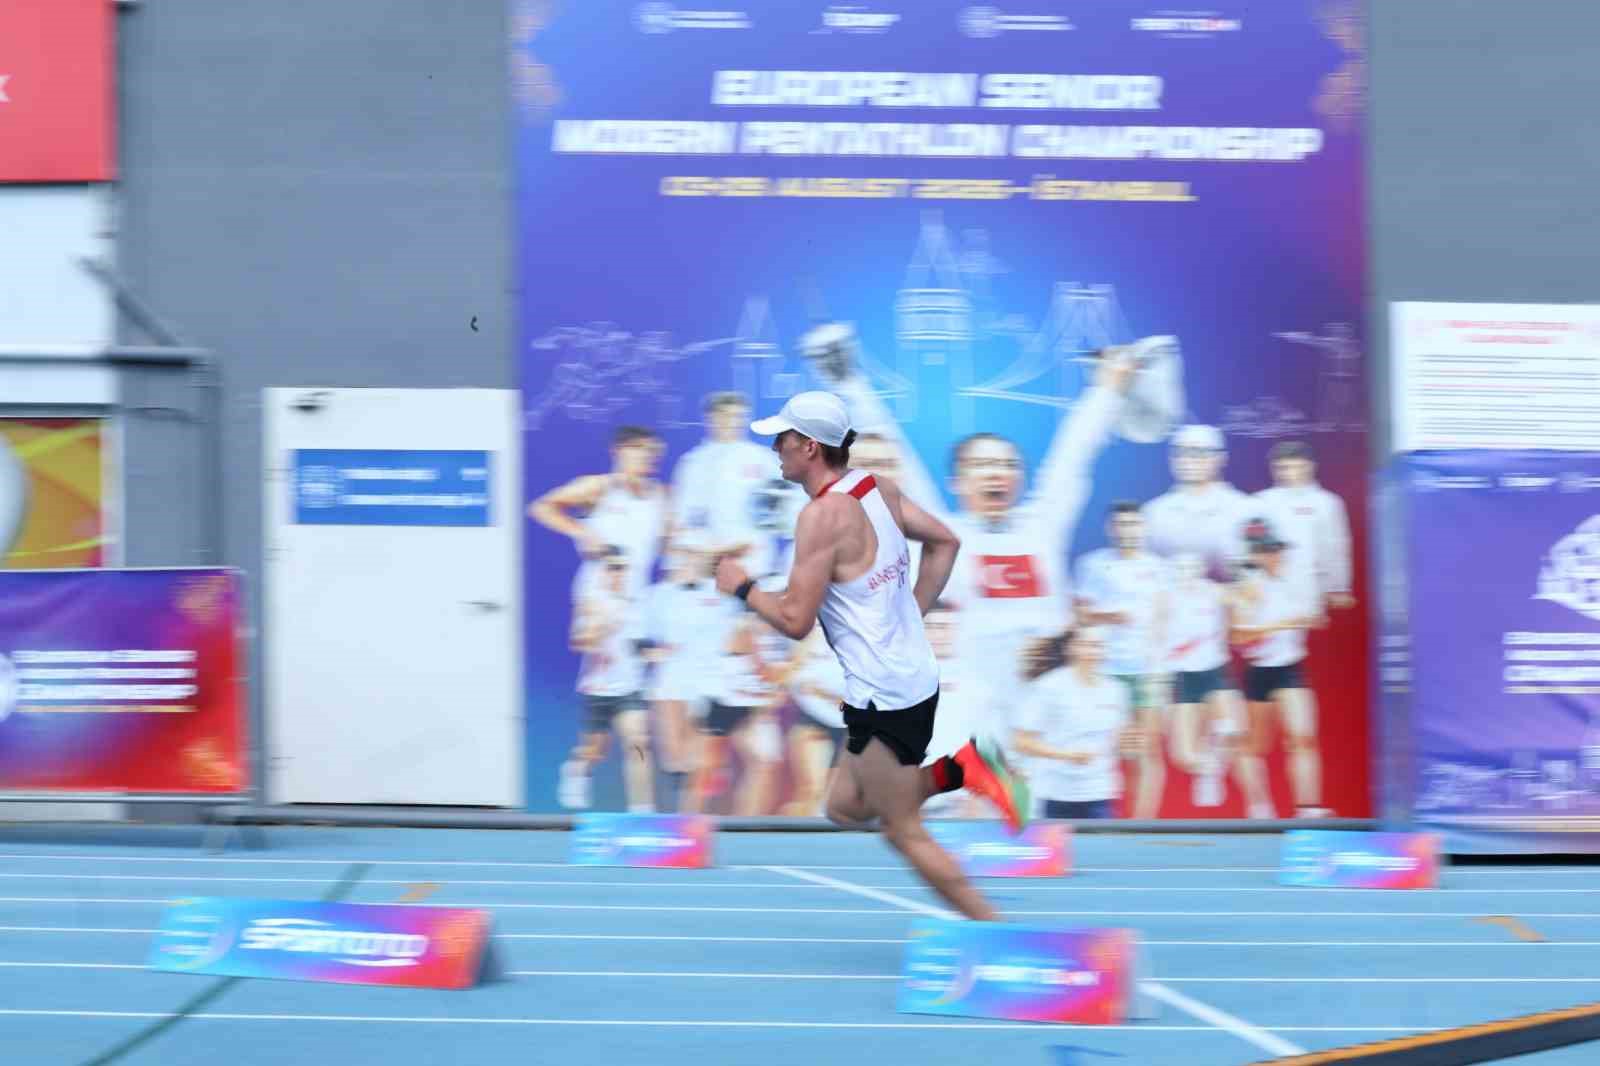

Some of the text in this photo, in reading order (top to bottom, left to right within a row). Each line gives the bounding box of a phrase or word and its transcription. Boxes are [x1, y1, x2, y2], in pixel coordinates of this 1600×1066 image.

[711, 70, 1164, 110] EUROPEAN SENIOR
[551, 119, 1324, 161] MODERN PENTATHLON CHAMPIONSHIP
